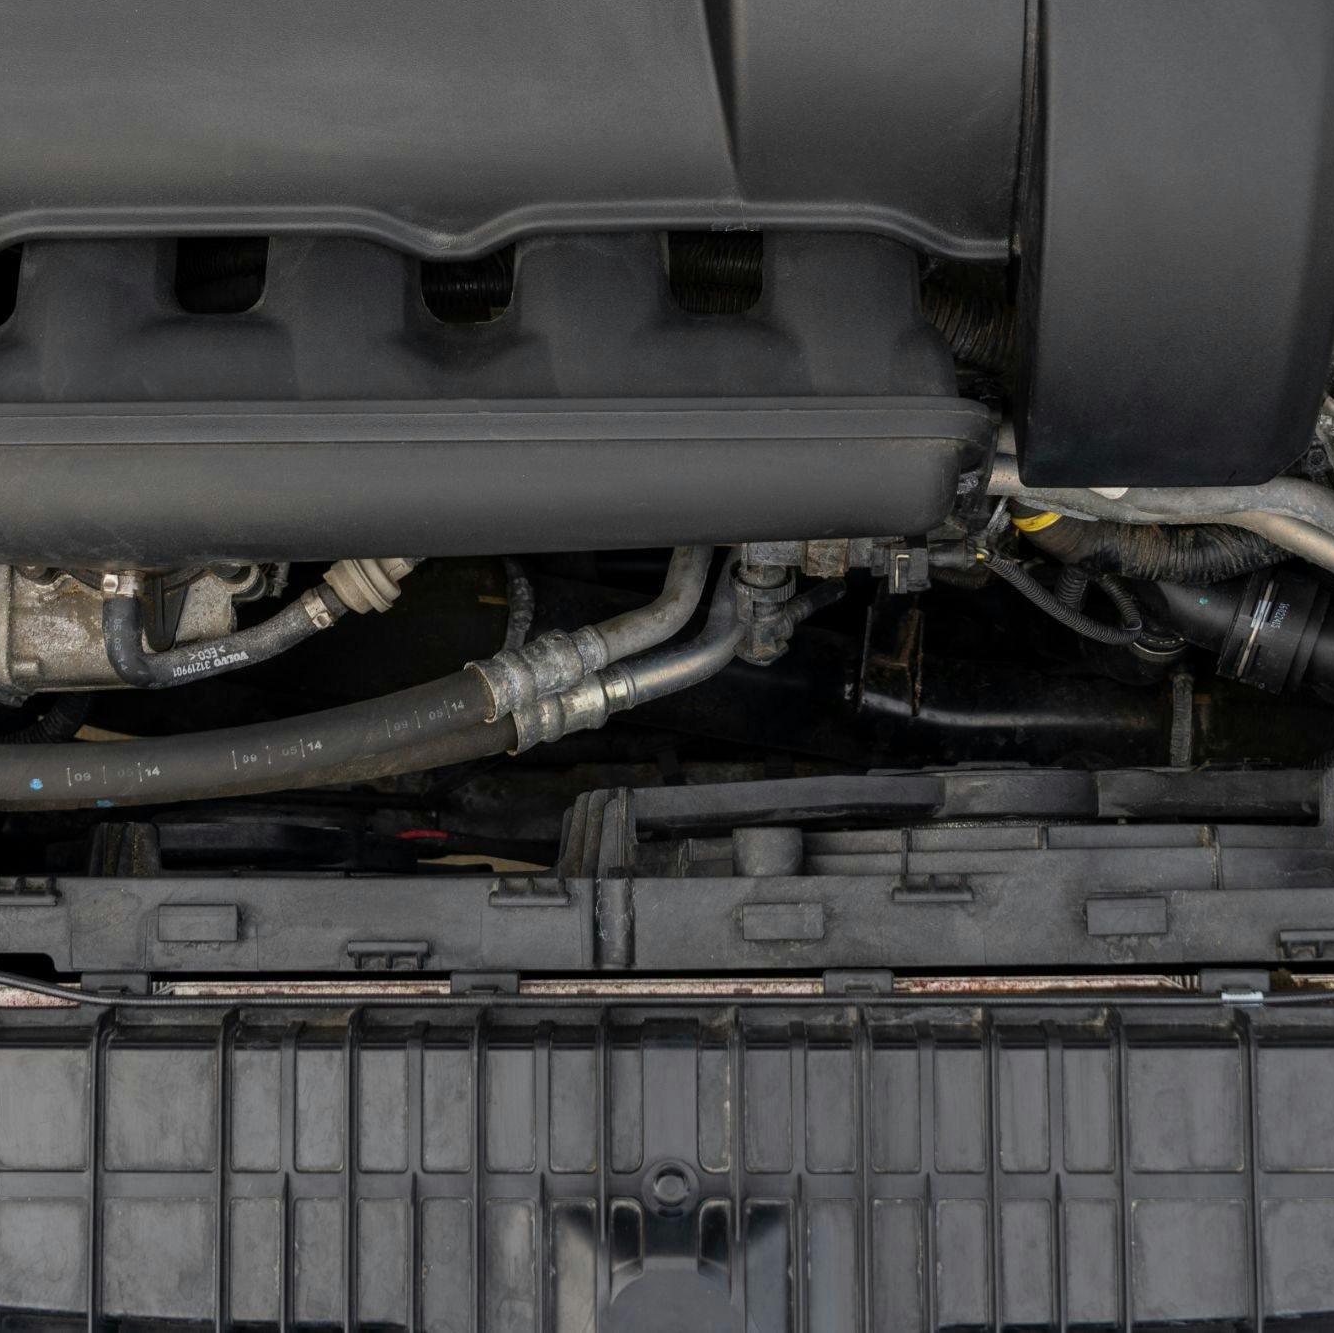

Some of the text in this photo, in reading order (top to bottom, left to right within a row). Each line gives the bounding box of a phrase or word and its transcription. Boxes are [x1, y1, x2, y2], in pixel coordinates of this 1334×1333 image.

[173, 651, 249, 677] VOLVO 31219901
[451, 699, 464, 712] 14
[307, 740, 323, 751] 14
[145, 765, 161, 778] 14
